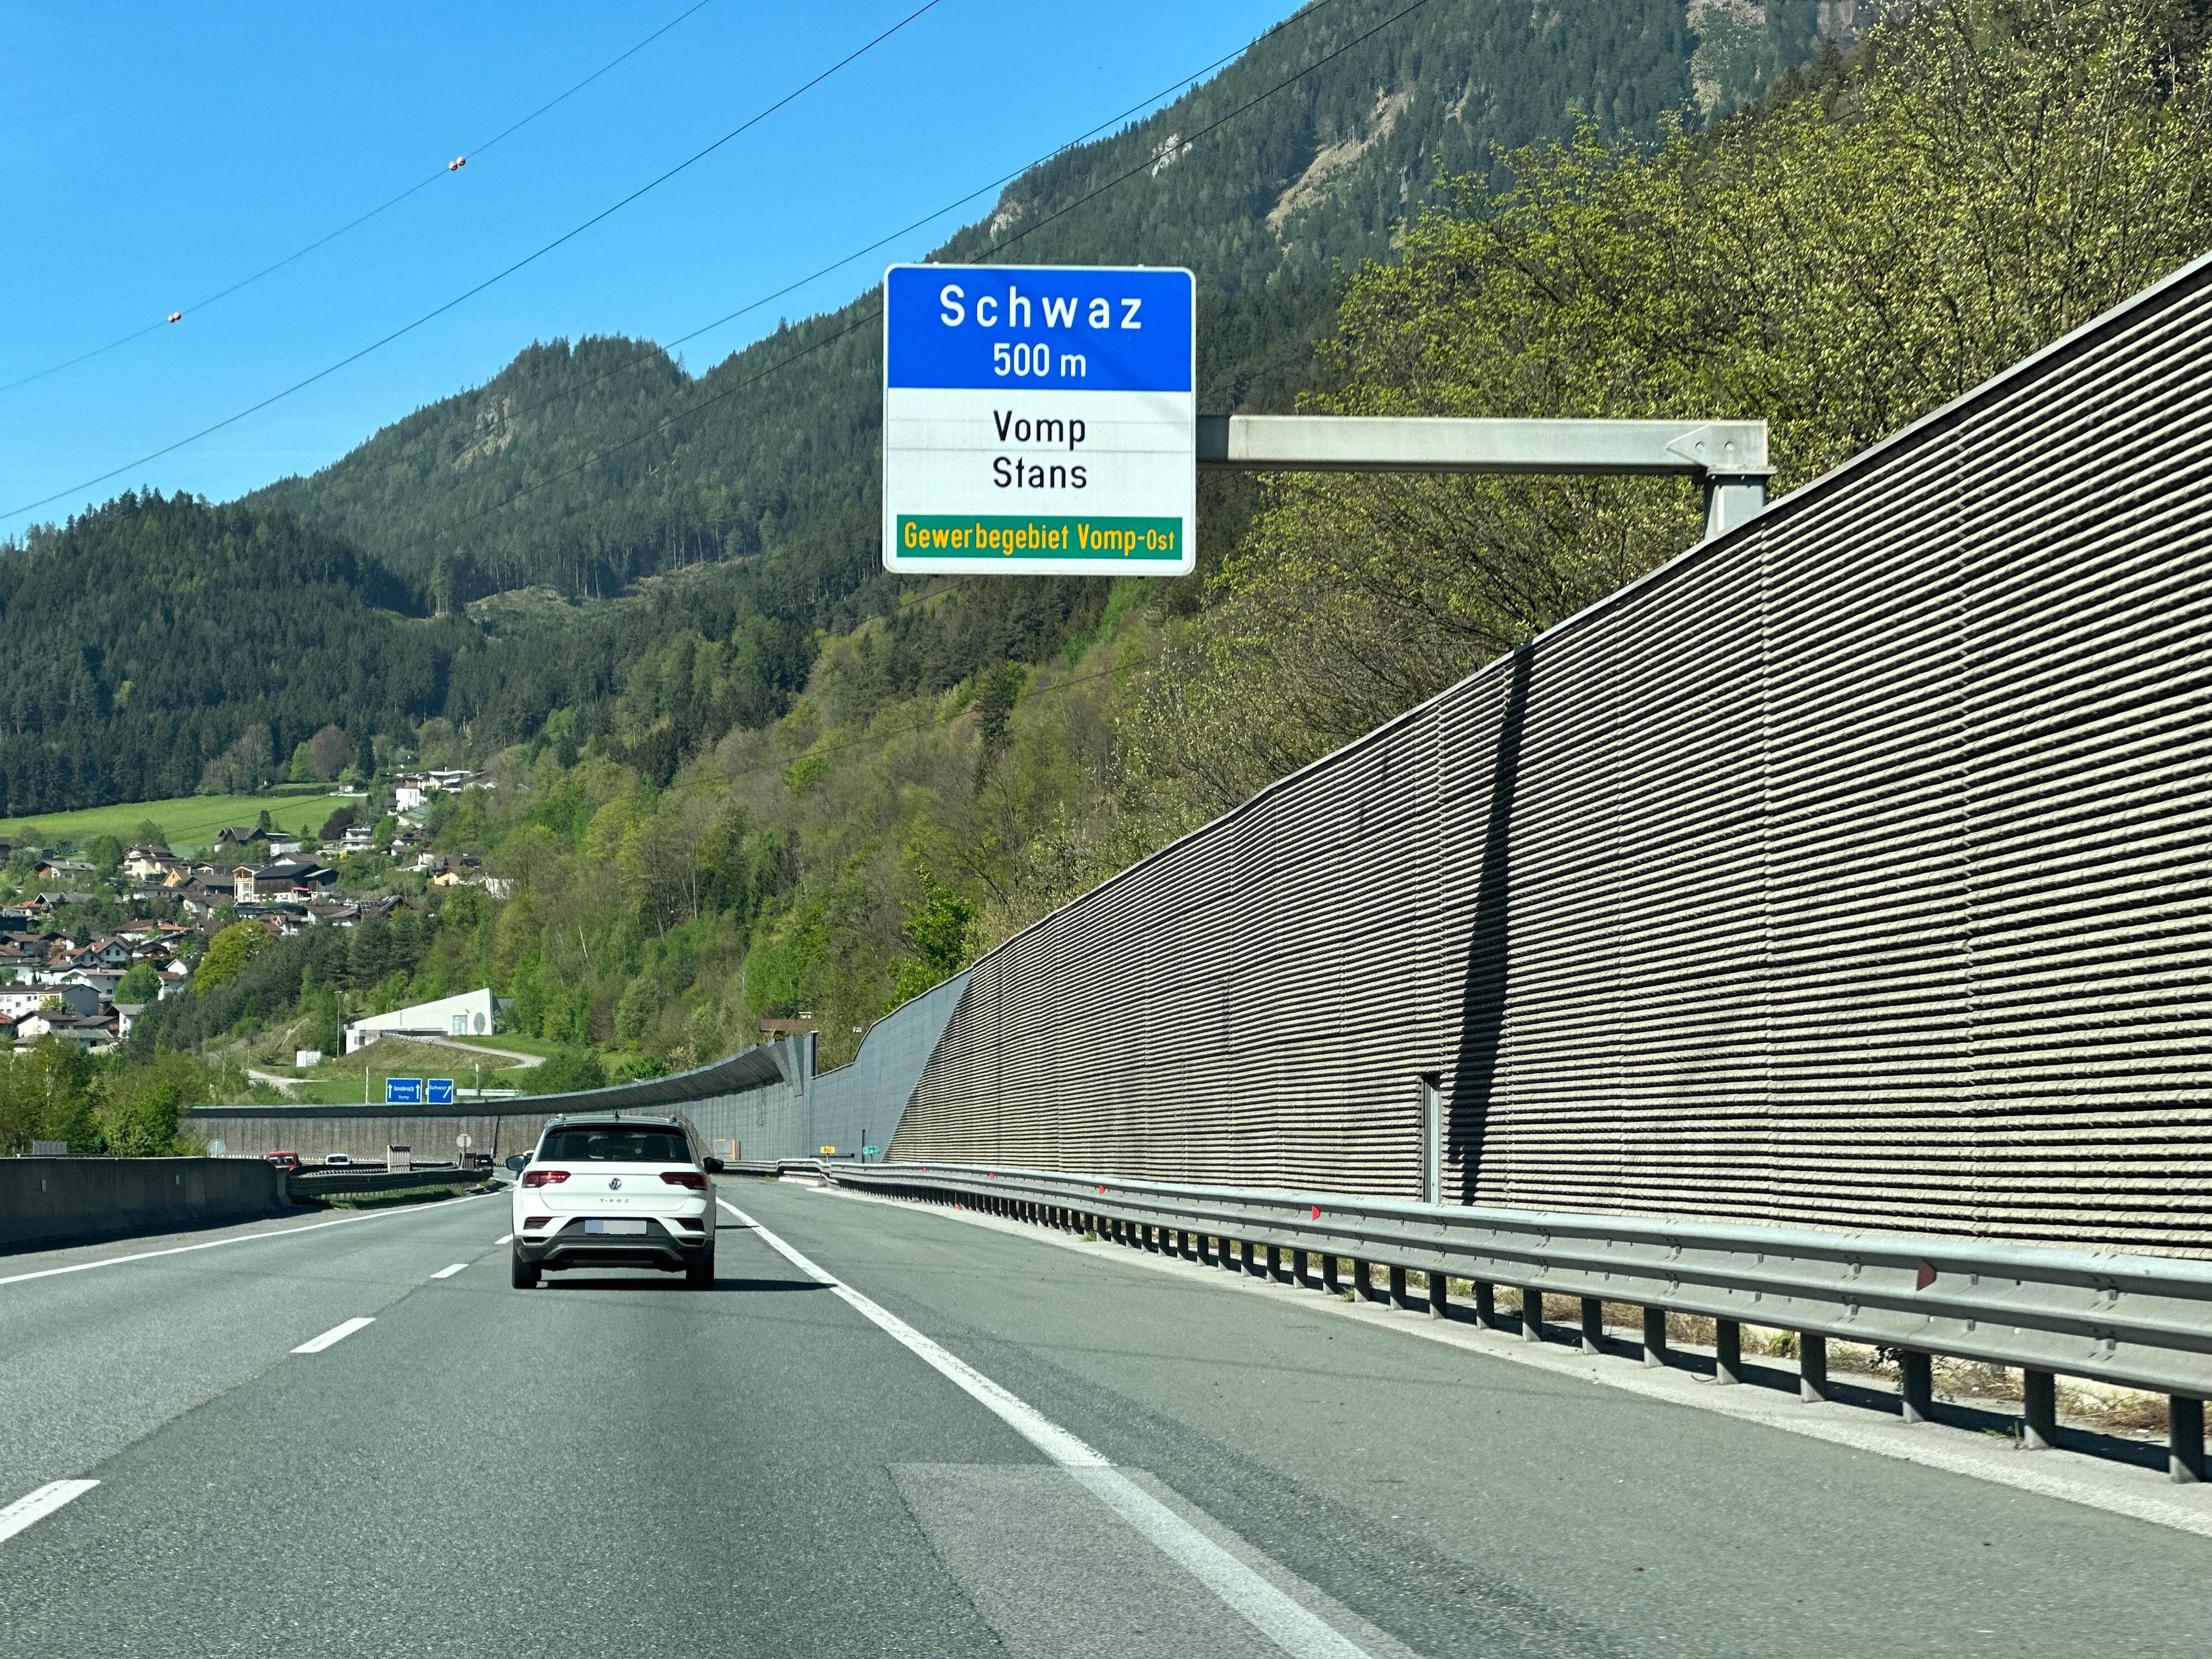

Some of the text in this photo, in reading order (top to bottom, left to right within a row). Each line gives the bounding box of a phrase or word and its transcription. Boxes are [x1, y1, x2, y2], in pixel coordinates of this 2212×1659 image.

[940, 284, 1142, 330] Schwaz
[994, 343, 1086, 377] 500 m
[993, 409, 1086, 451] Vomp
[993, 456, 1087, 488] Stans
[904, 521, 1175, 556] Gewerbegebiet Vomp-Ost
